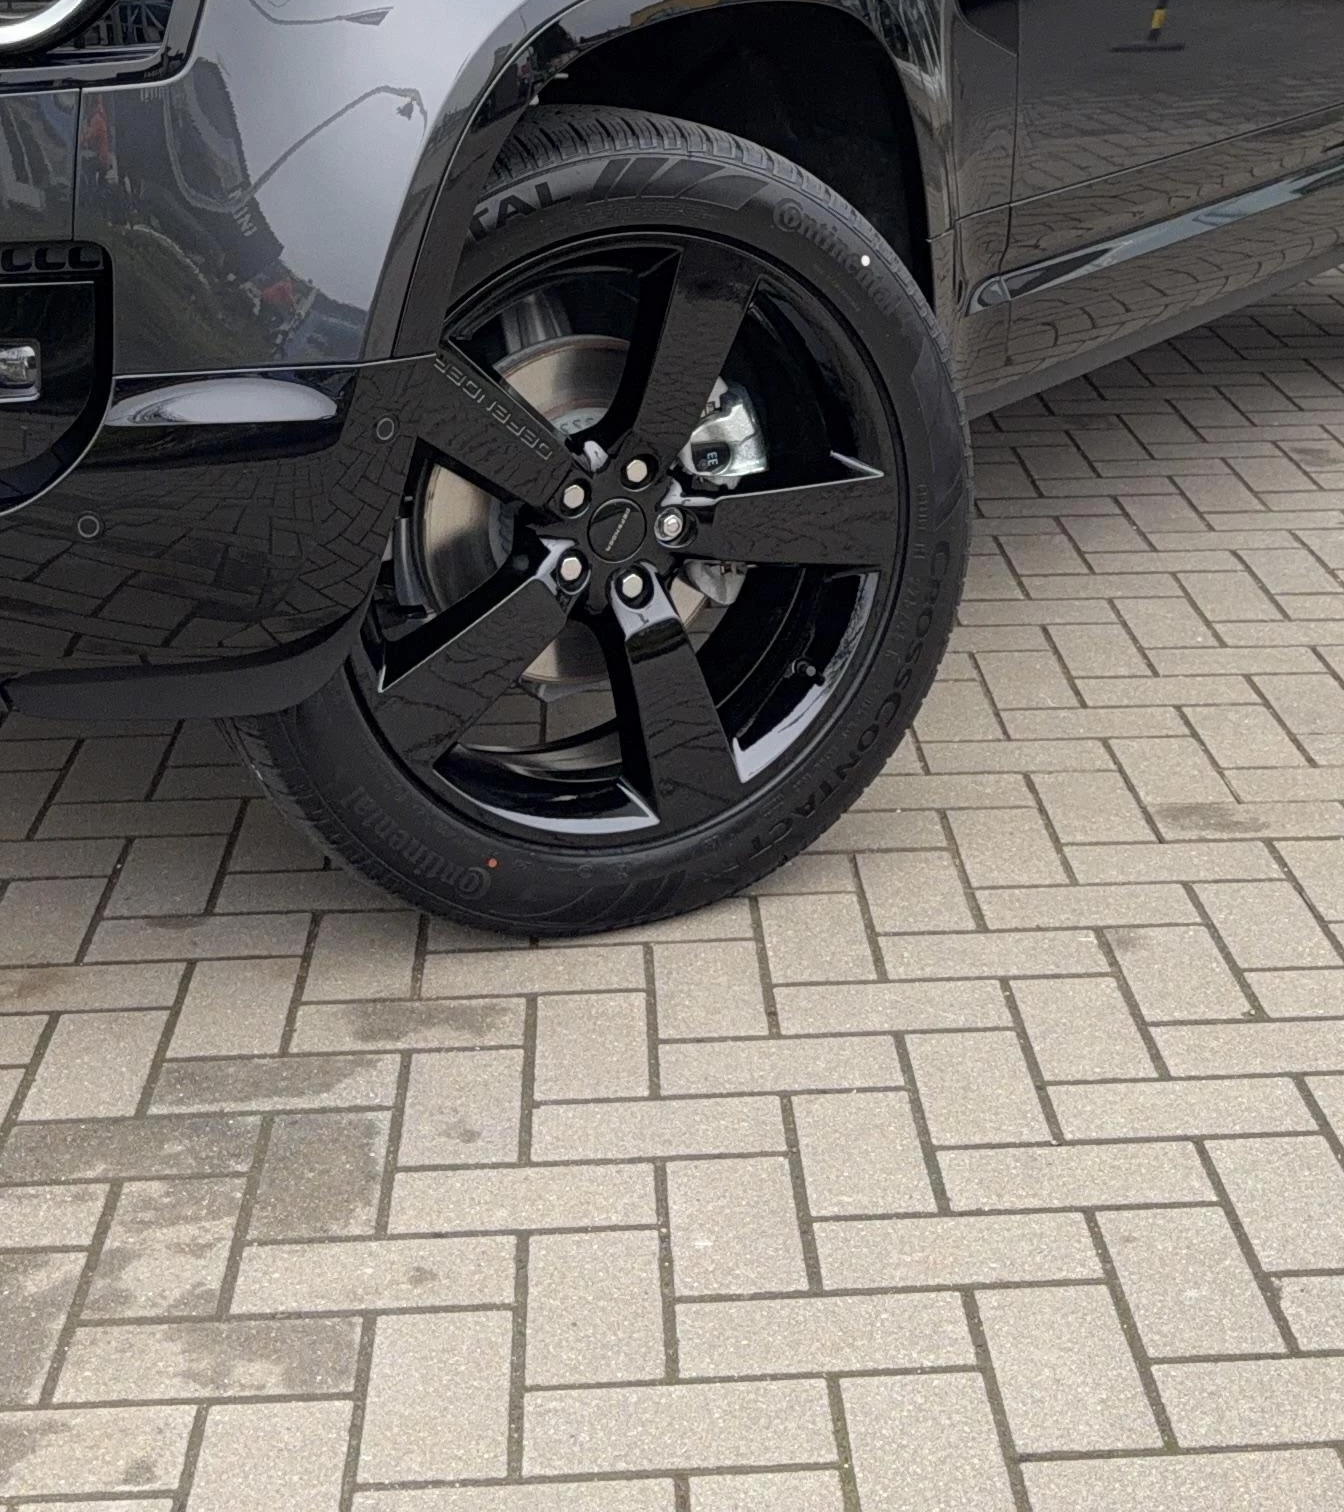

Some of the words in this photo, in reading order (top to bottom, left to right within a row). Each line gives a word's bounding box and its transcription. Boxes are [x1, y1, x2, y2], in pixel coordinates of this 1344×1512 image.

[773, 197, 902, 317] Continental
[433, 356, 553, 461] DEFENDER
[340, 786, 492, 900] Continental
